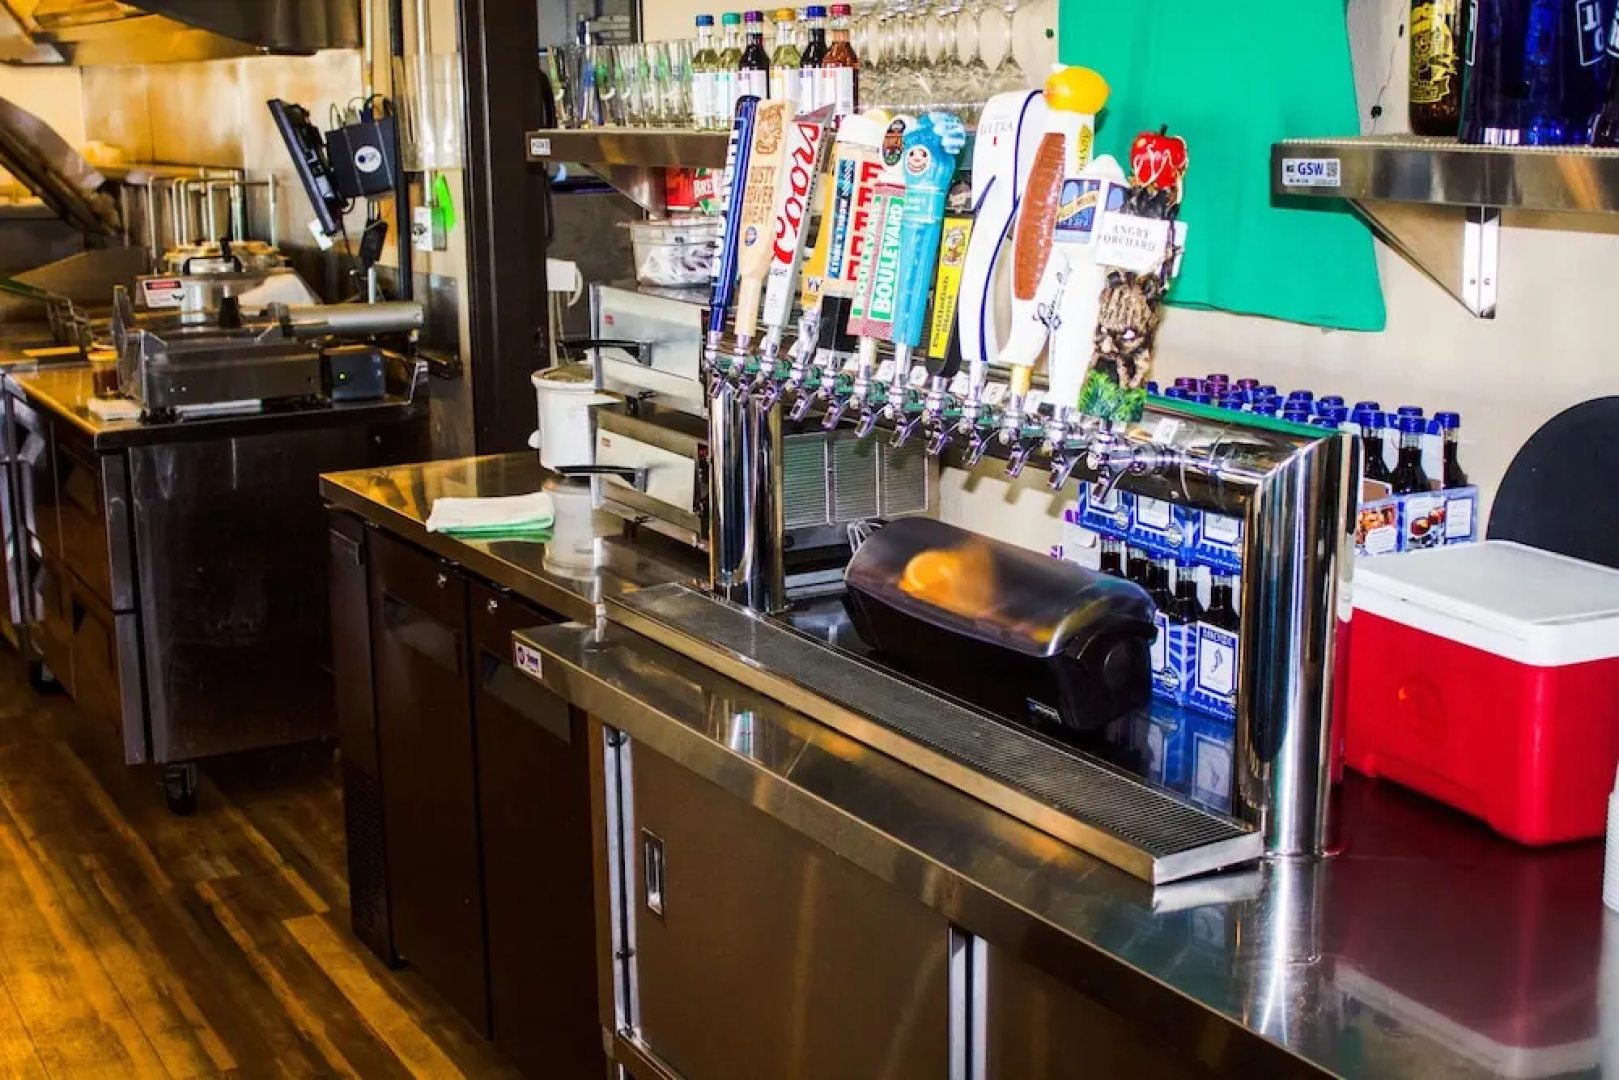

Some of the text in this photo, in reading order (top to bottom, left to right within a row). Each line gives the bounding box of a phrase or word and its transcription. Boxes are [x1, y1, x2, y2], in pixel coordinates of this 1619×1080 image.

[1298, 161, 1324, 175] GSW
[772, 122, 820, 264] Coors
[1112, 224, 1149, 239] ANGRY
[1103, 234, 1156, 251] ORCHARD
[873, 203, 903, 310] BOULEVARD
